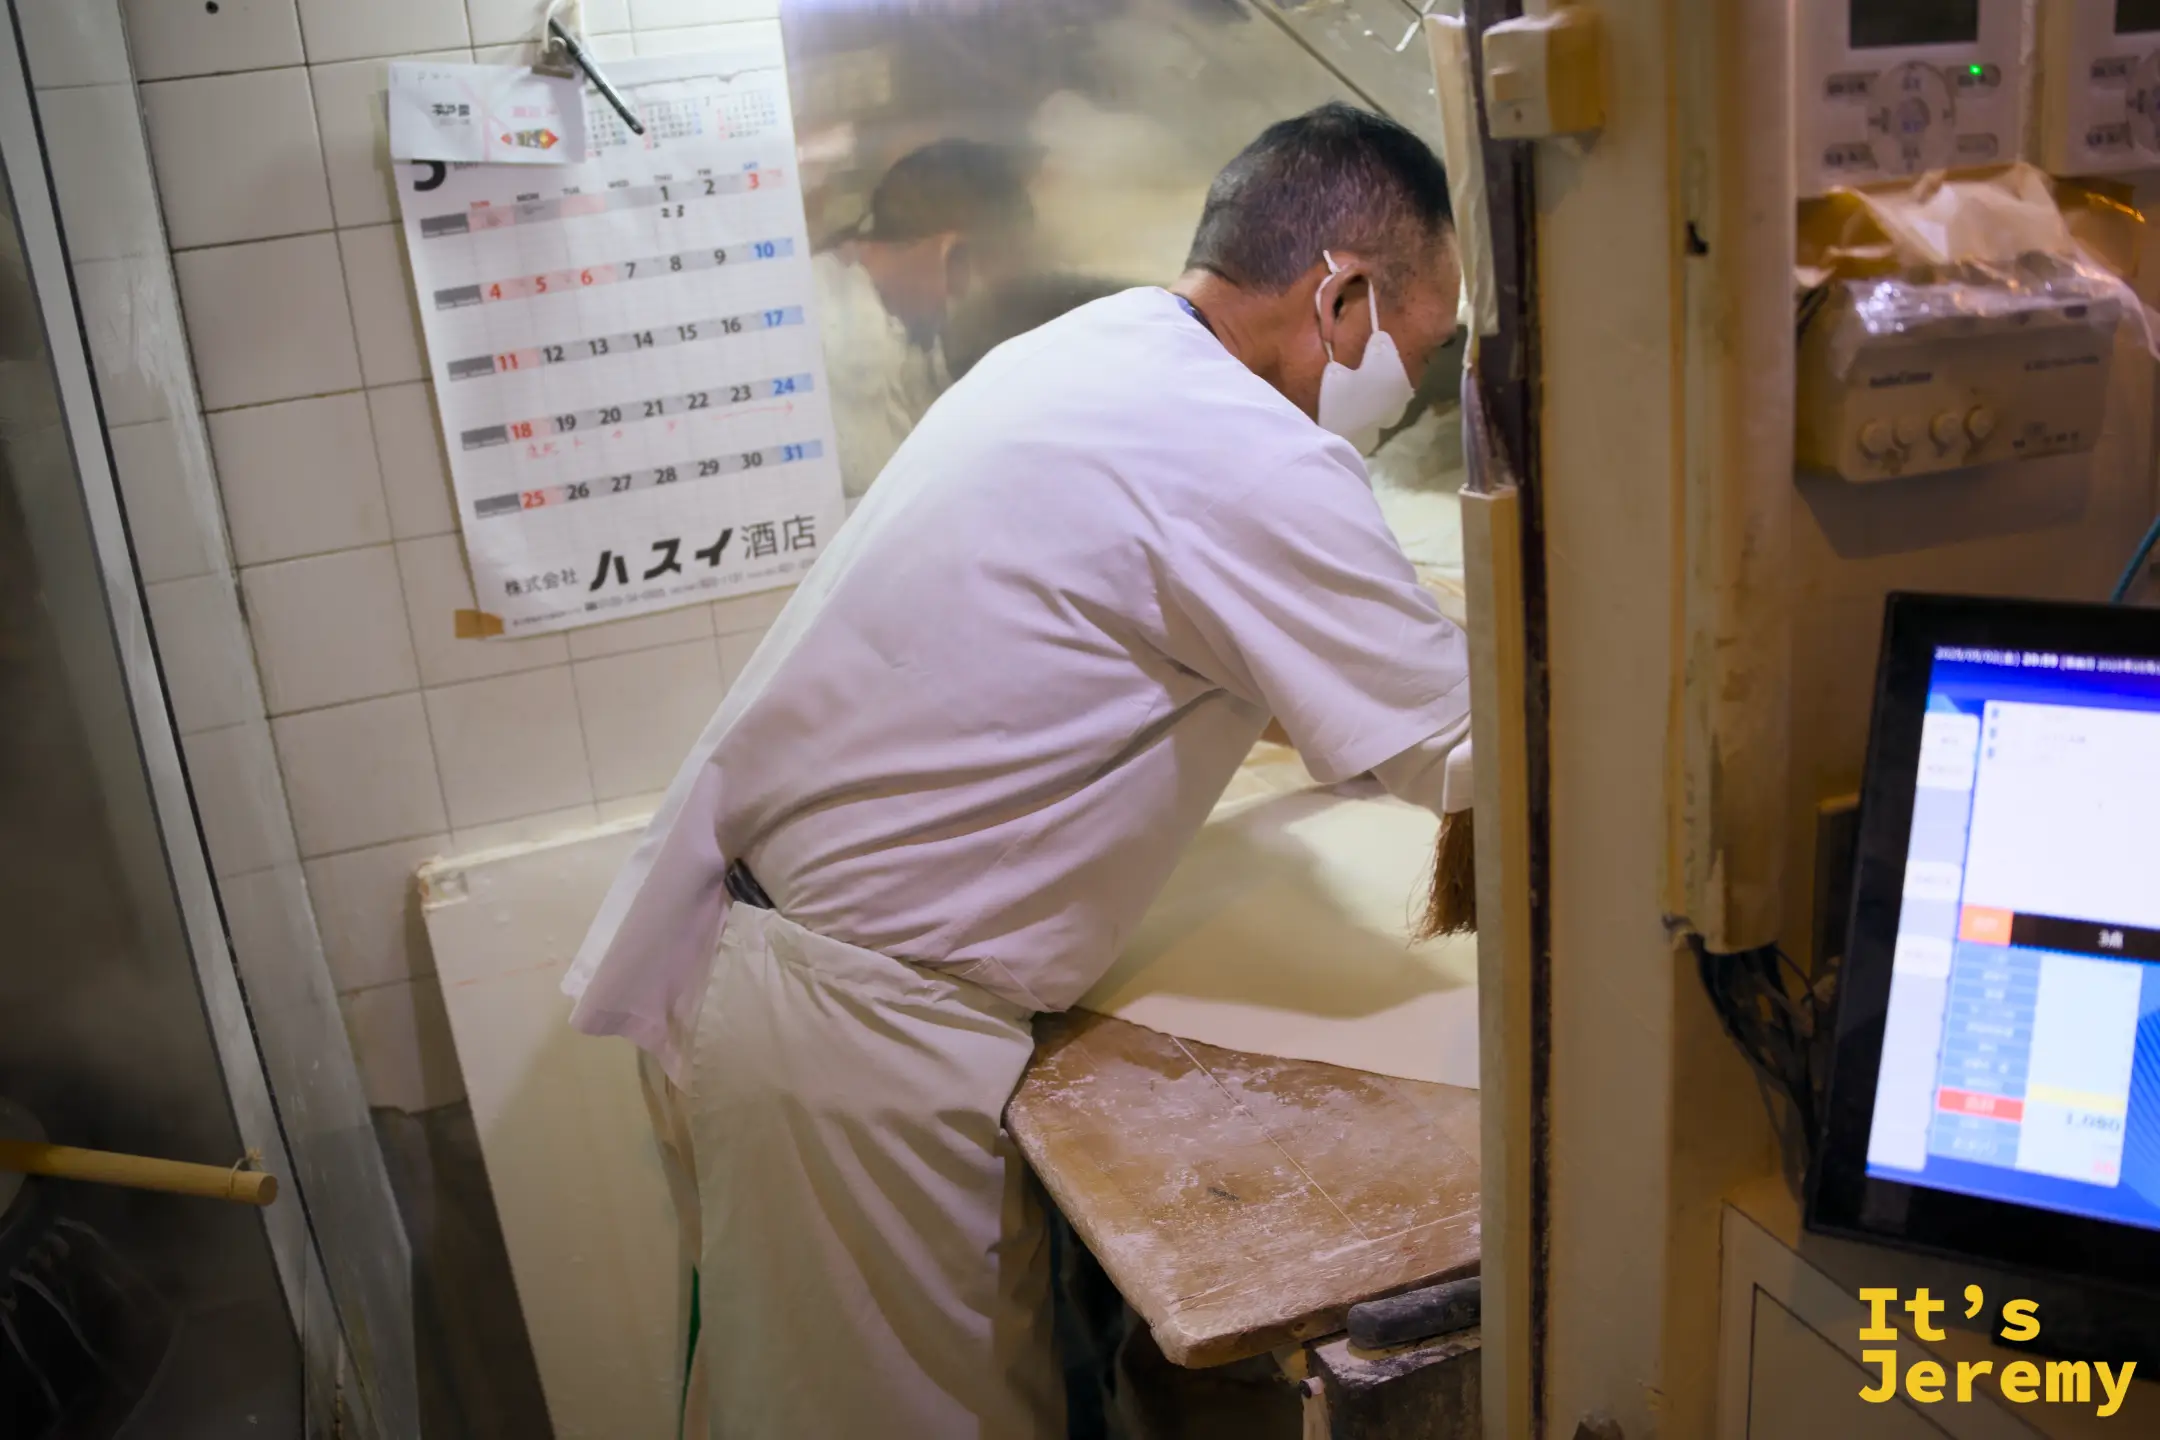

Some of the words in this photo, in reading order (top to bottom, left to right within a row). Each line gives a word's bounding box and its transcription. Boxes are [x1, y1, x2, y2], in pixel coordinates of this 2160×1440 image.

[659, 185, 669, 201] 1
[704, 178, 716, 196] 2
[748, 172, 760, 190] 3
[489, 283, 502, 300] 4
[535, 275, 548, 294] 5
[580, 269, 594, 286] 6
[625, 261, 637, 279] 7
[669, 255, 683, 272] 8
[713, 249, 727, 266] 9
[753, 241, 776, 259] 10
[498, 353, 519, 371] 11
[542, 345, 565, 363] 12
[588, 338, 610, 356] 13
[632, 330, 654, 349] 14
[676, 323, 698, 342] 15
[720, 317, 742, 335] 16
[764, 309, 785, 327] 17
[510, 422, 533, 440] 18
[555, 414, 577, 432] 19
[598, 406, 622, 426] 20
[643, 399, 664, 418] 21
[687, 392, 709, 411] 22
[730, 384, 752, 403] 23
[772, 377, 796, 396] 24
[522, 489, 546, 509] 25
[567, 482, 590, 501] 26
[611, 474, 632, 493] 27
[654, 466, 678, 485] 28
[697, 459, 720, 477] 29
[740, 451, 764, 470] 30
[783, 443, 804, 462] 31
[504, 567, 578, 597] 株式会社
[588, 514, 817, 592] ハスイ酒店
